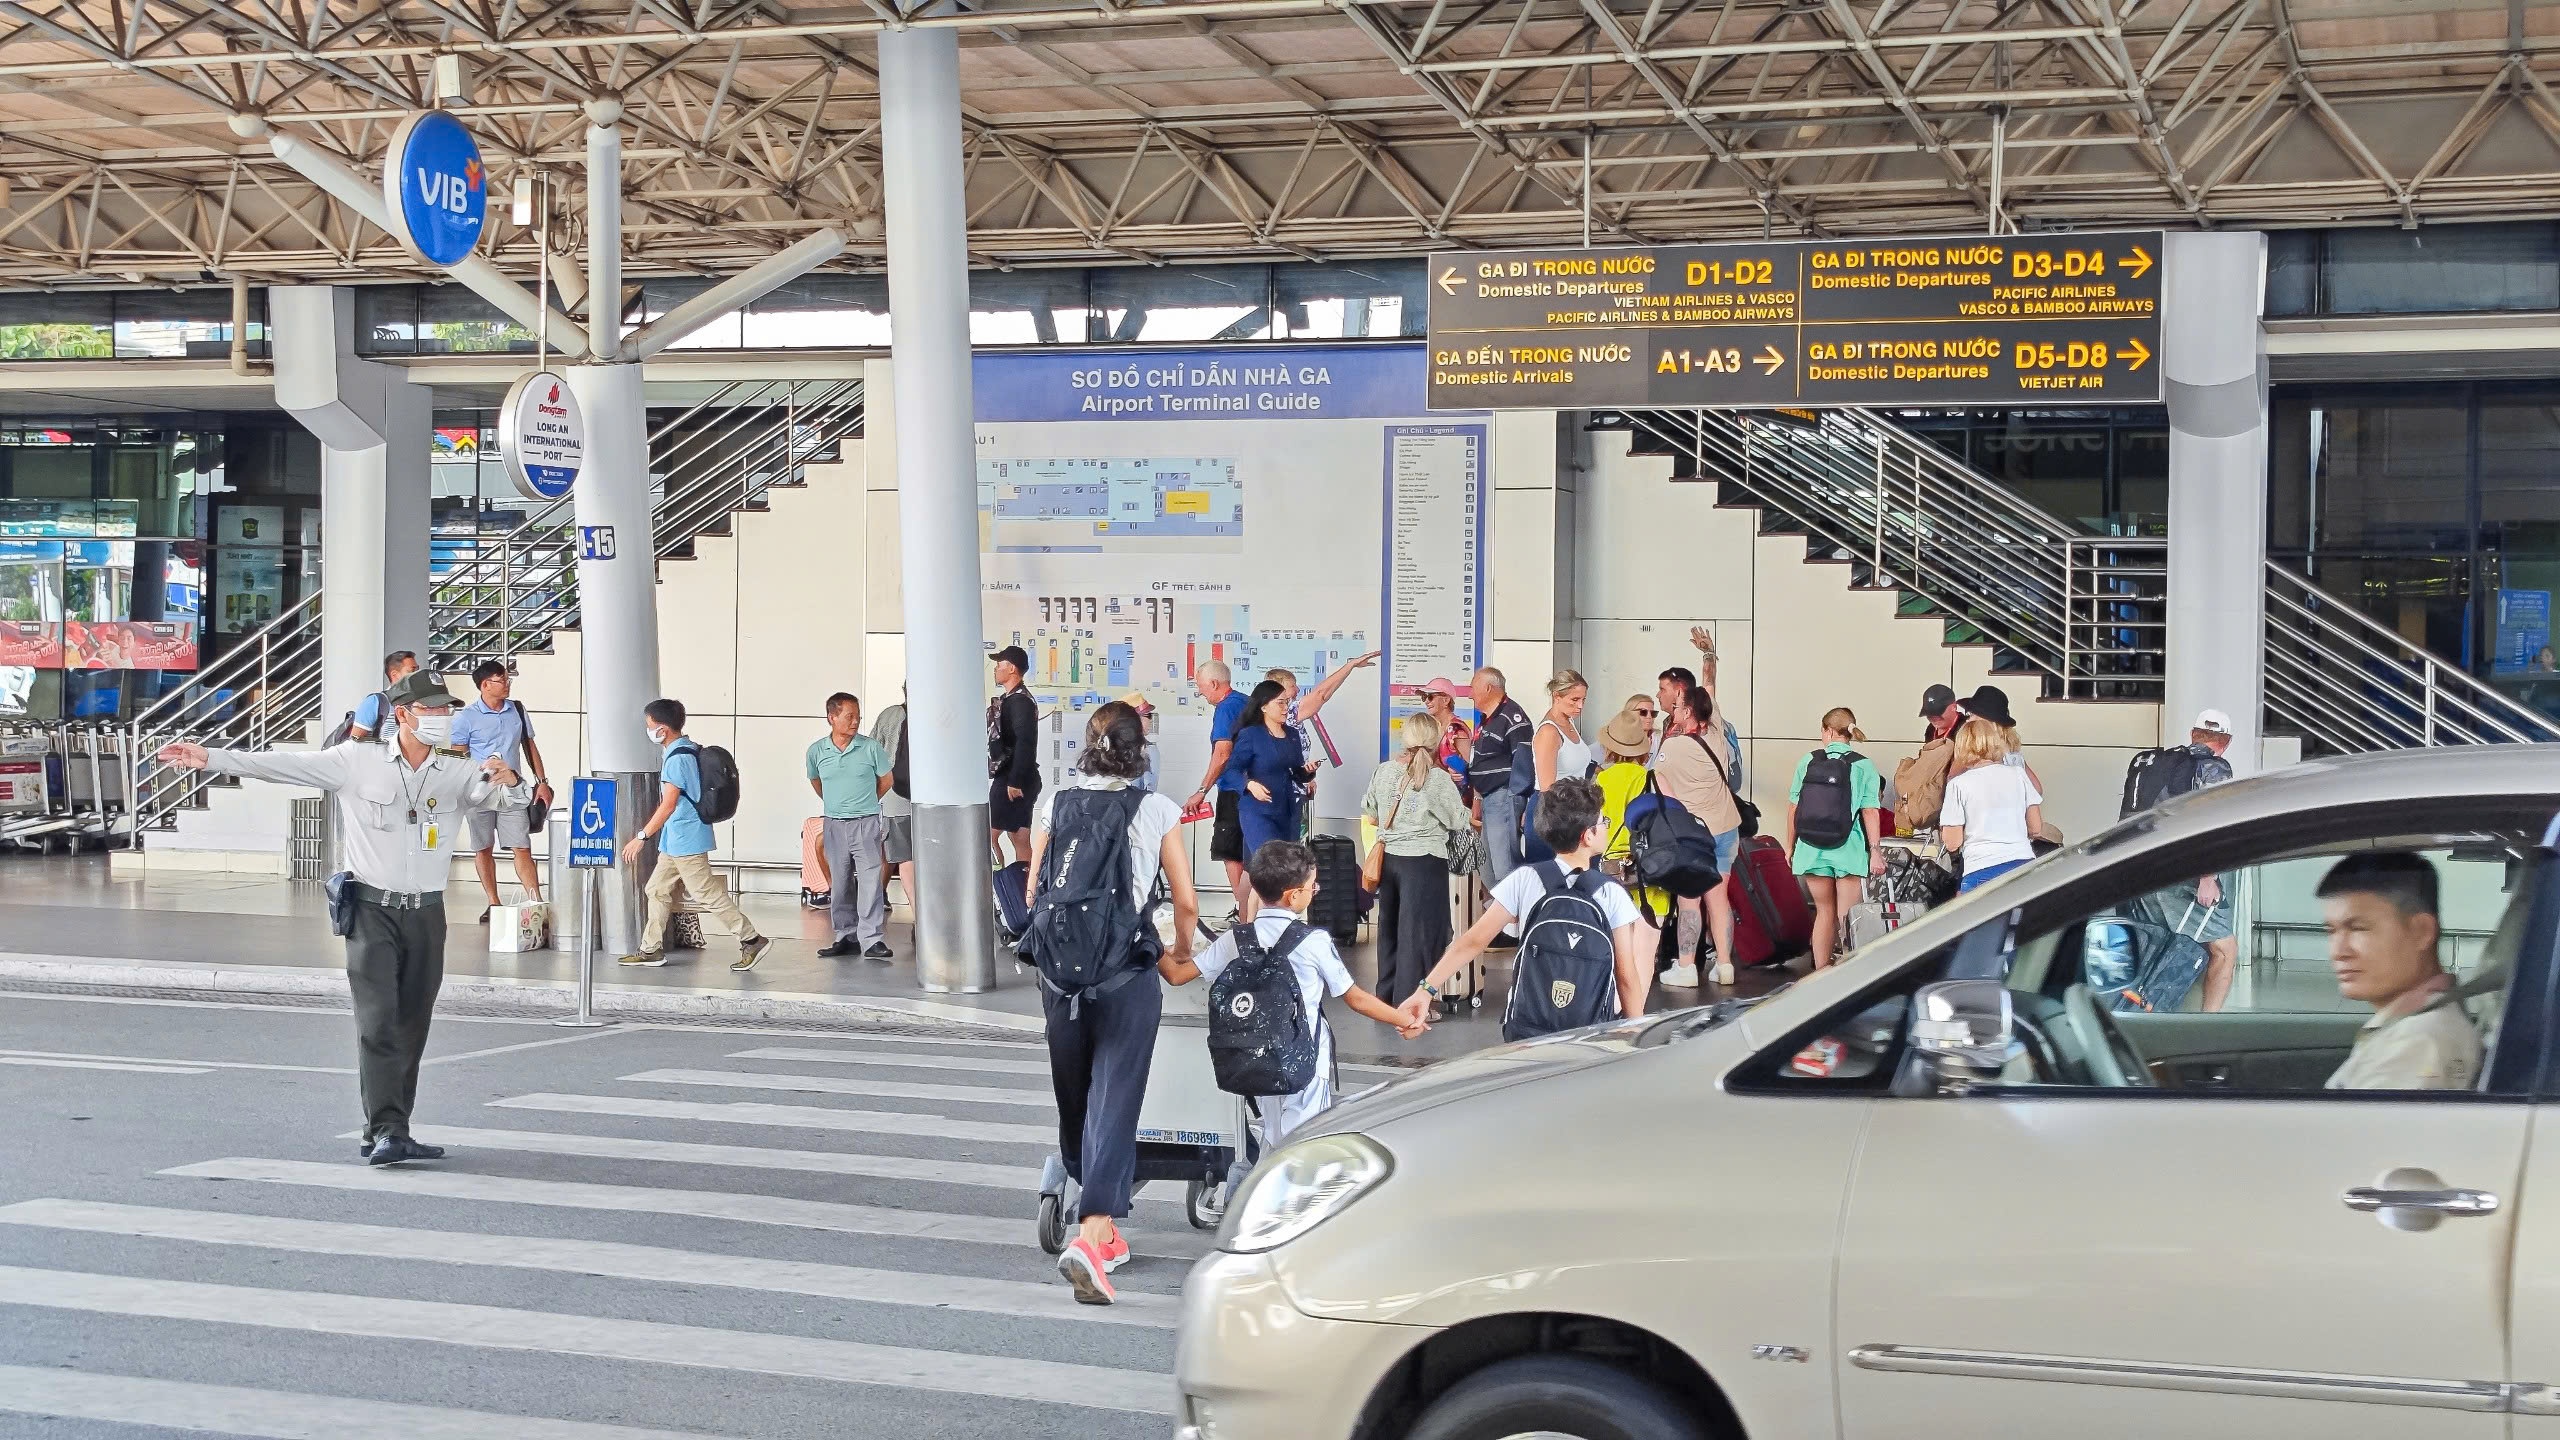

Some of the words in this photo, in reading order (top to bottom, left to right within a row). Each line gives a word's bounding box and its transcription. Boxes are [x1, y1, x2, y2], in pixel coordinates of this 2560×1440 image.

[418, 168, 467, 213] VIB
[1812, 253, 1839, 268] GA
[1845, 252, 1864, 267] ĐI
[1870, 250, 1939, 266] TRONG
[1946, 246, 2003, 264] NƯỚC
[2013, 252, 2105, 277] D3-D4
[1479, 263, 1504, 278] GA
[1509, 262, 1527, 277] ĐI
[1533, 261, 1597, 276] TRONG
[1603, 256, 1655, 274] NƯỚC
[1687, 261, 1772, 286] D1-D2
[1812, 274, 1890, 288] Domestic
[1896, 272, 1991, 289] Departures
[1478, 282, 1551, 298] Domestic
[1556, 281, 1644, 298] Departures
[1993, 288, 2047, 299] PACIFIC
[2051, 286, 2116, 298] AIRLINES
[1614, 296, 1670, 307] VIETNAM
[1674, 295, 1733, 306] AIRLINES
[1737, 294, 1745, 305] &
[1749, 293, 1795, 304] VASCO
[1959, 303, 2007, 315] VASCO
[2010, 303, 2020, 314] &
[2024, 301, 2085, 313] BAMBOO
[2089, 300, 2154, 312] AIRWAYS
[1547, 312, 1596, 323] PACIFIC
[1600, 311, 1658, 322] AIRLINES
[1662, 310, 1670, 321] &
[1674, 309, 1731, 321] BAMBOO
[1734, 308, 1794, 320] AIRWAYS
[1435, 351, 1461, 366] GA
[1466, 345, 1504, 365] ĐẾN
[1509, 349, 1573, 364] TRONG
[1578, 343, 1631, 363] NƯỚC
[1809, 344, 1837, 359] GA
[1843, 343, 1862, 359] ĐI
[1868, 342, 1937, 358] TRONG
[1943, 338, 2000, 357] NƯỚC
[2015, 343, 2108, 368] D5-D8
[1657, 350, 1741, 373] A1-A3
[1071, 369, 1102, 389] SƠ
[1108, 363, 1139, 388] ĐỒ
[1146, 363, 1183, 388] CHỈ
[1191, 361, 1237, 387] DẪN
[1244, 363, 1292, 386] NHÀ
[1298, 367, 1332, 385] GA
[1435, 371, 1508, 384] Domestic
[1512, 370, 1573, 384] Arrivals
[1809, 365, 1888, 380] Domestic
[1893, 364, 1988, 381] Departures
[2019, 377, 2076, 389] VIETJET
[2079, 376, 2103, 388] AIR
[1081, 395, 1154, 416] Airport
[1159, 393, 1250, 412] Terminal
[1257, 392, 1321, 411] Guide
[537, 422, 557, 433] LONG
[558, 424, 569, 434] AN
[523, 434, 581, 450] INTERNATIONAL
[543, 450, 562, 461] PORT
[1152, 582, 1168, 591] GF
[1056, 838, 1079, 888] Quechua
